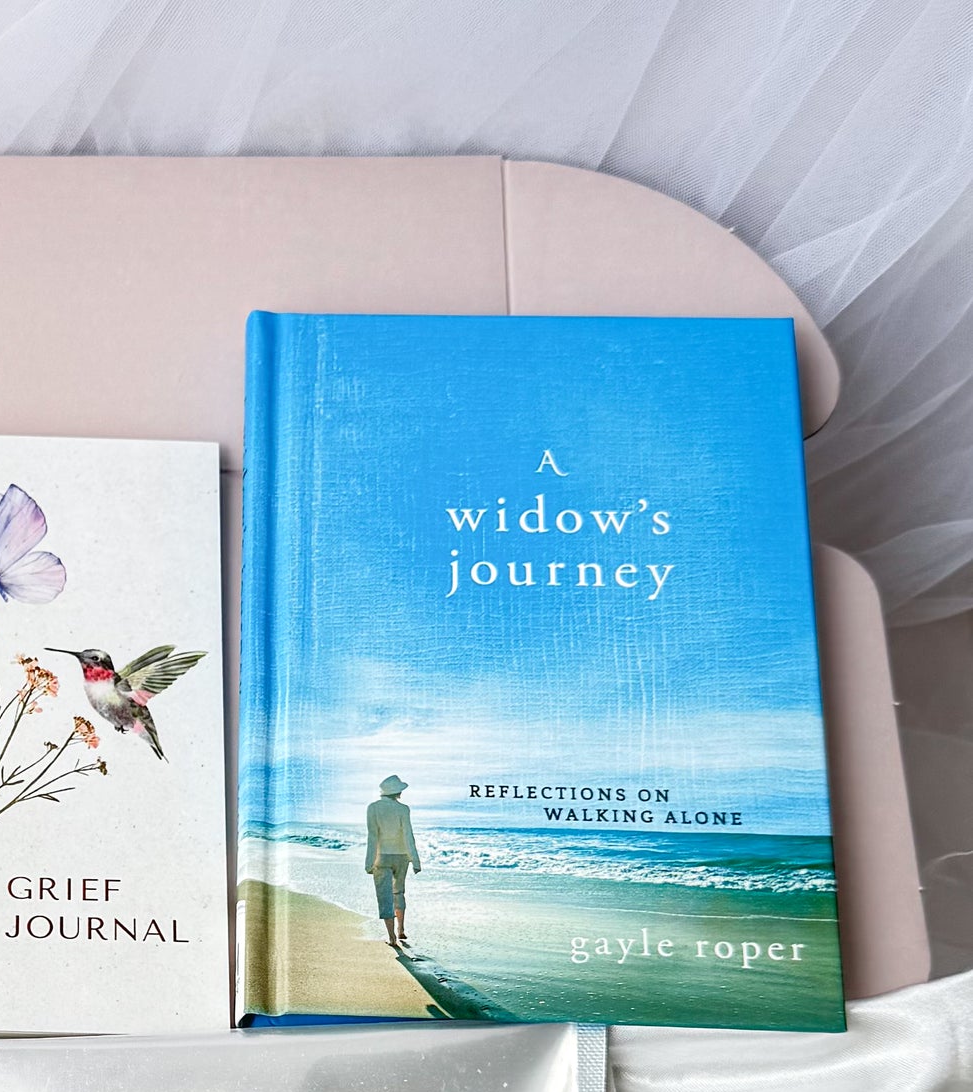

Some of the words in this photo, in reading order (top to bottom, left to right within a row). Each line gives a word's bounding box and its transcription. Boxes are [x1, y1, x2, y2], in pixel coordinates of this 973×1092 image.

[535, 449, 569, 477] A
[446, 550, 675, 601] journey
[469, 784, 628, 802] REFLECTIONS
[638, 787, 670, 803] ON
[544, 807, 655, 824] WALKING
[664, 810, 743, 826] ALONE
[7, 876, 121, 901] GRIEF
[5, 915, 189, 943] JOURNAL
[570, 928, 674, 965] gayle
[695, 937, 806, 969] roper
